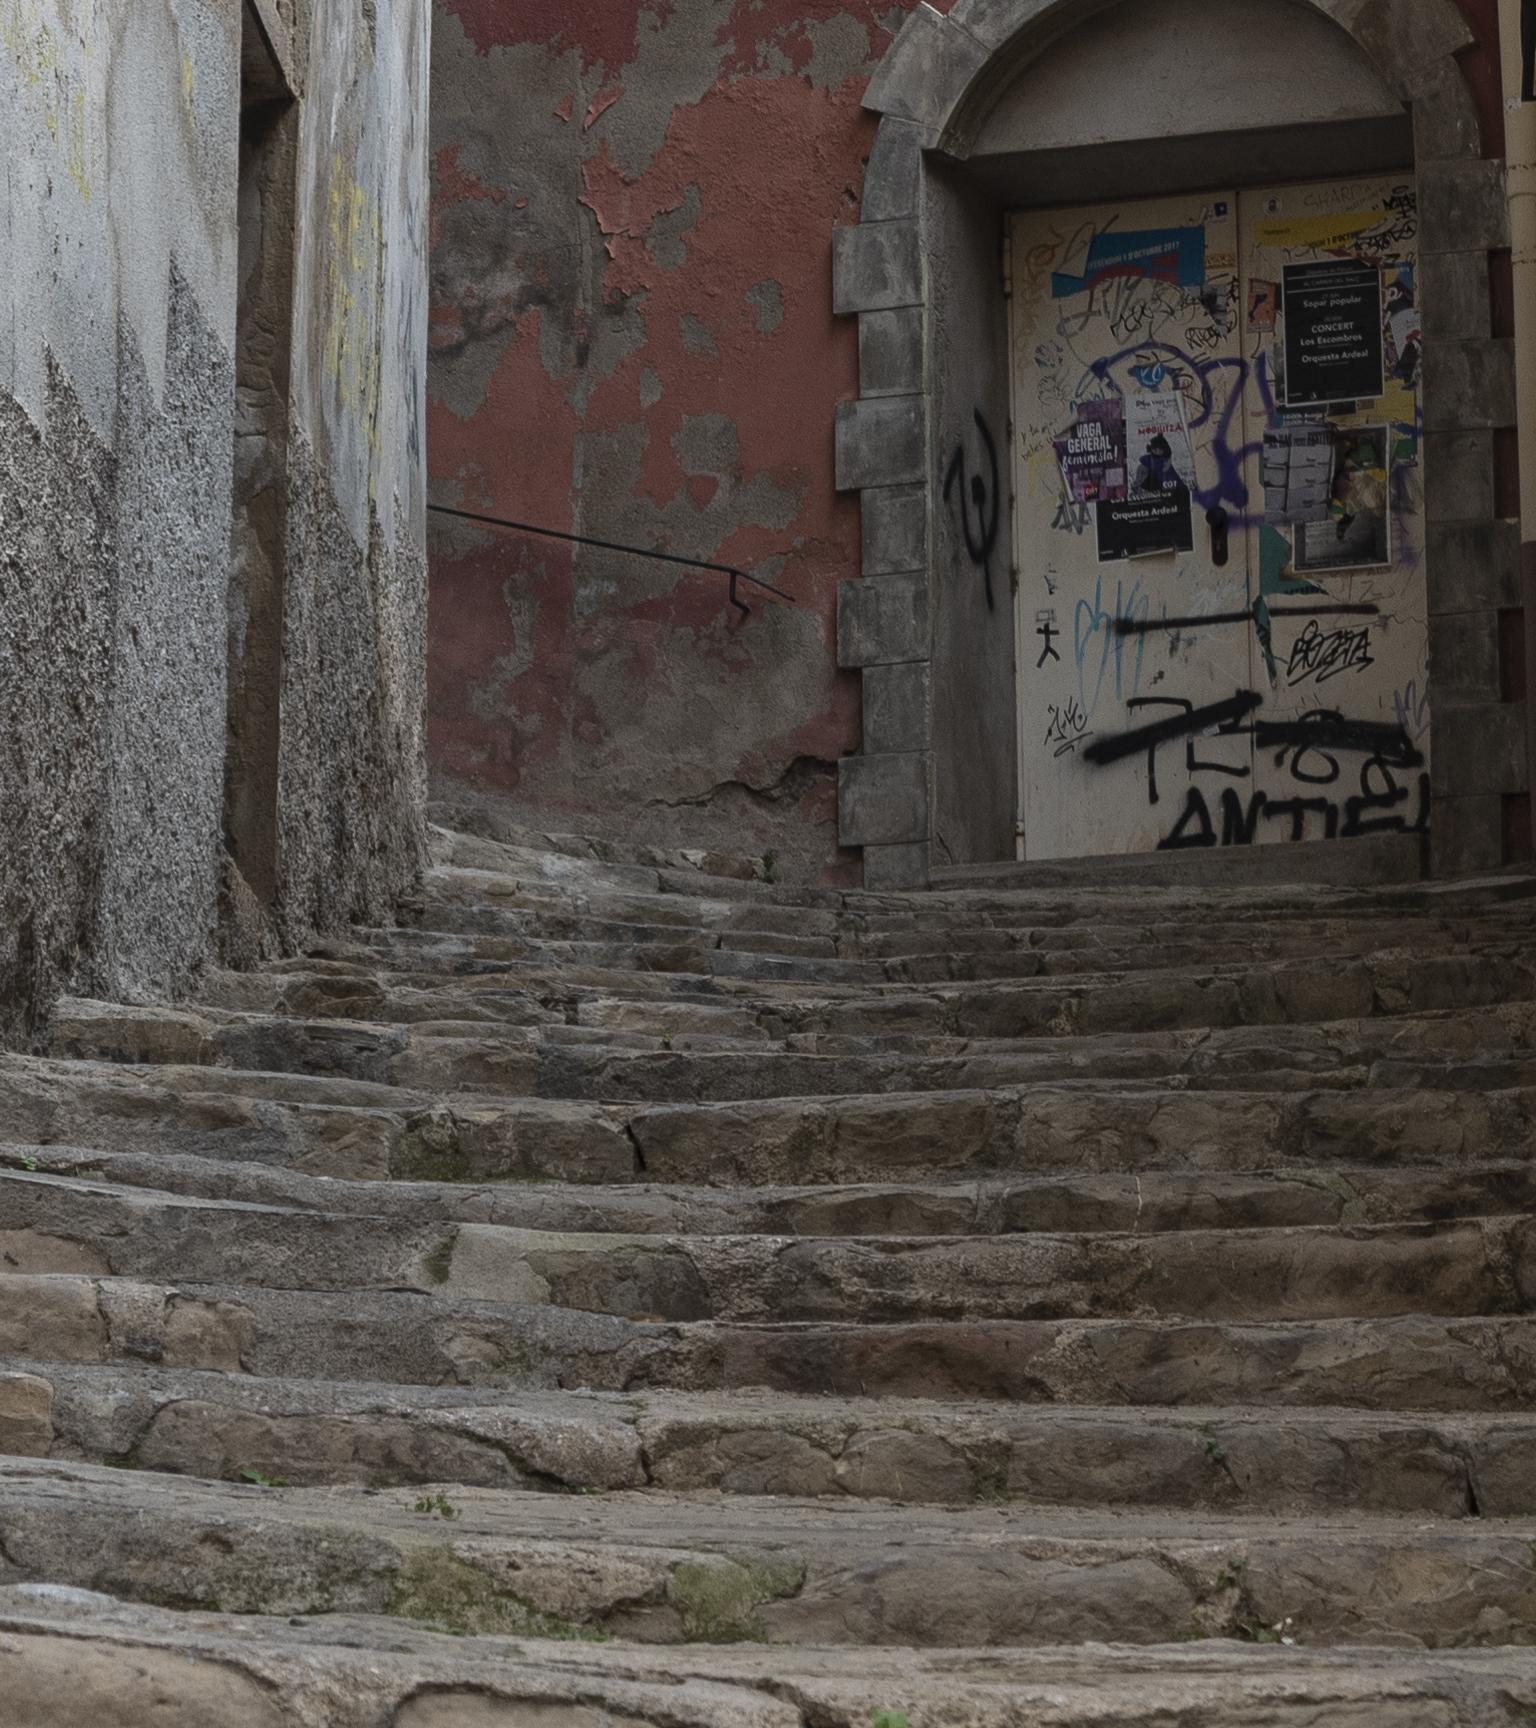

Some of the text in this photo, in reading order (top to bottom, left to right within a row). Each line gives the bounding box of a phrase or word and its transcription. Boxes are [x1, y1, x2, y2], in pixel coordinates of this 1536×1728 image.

[1311, 321, 1354, 334] CONCERT
[1076, 422, 1102, 438] VAGA
[1067, 435, 1112, 454] GENERAL
